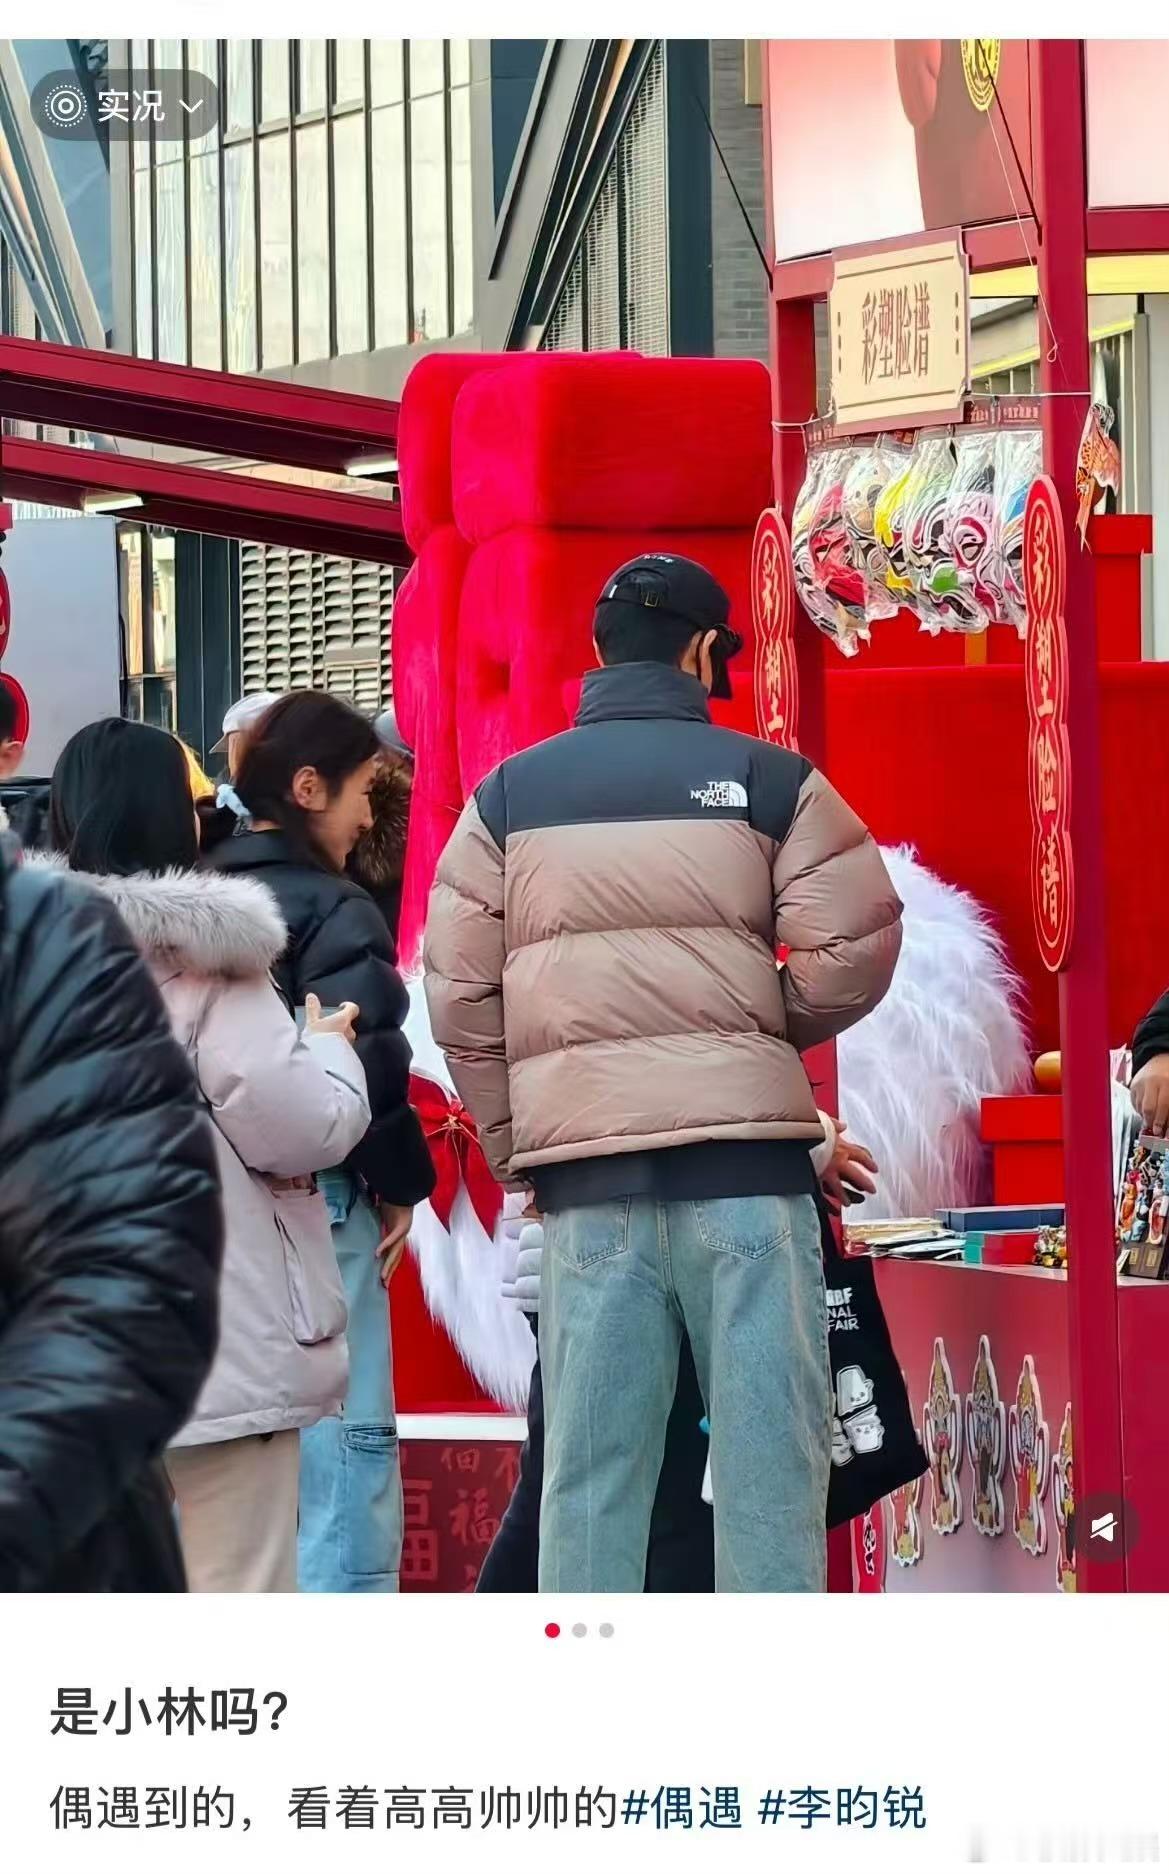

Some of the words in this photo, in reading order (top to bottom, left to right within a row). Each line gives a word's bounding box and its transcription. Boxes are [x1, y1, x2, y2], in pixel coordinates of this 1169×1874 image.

[861, 281, 930, 385] 彩塑脸谱
[1031, 514, 1059, 928] 彩塑脸谱
[706, 781, 730, 790] THE
[690, 789, 729, 800] NORTH
[701, 798, 730, 807] FACE
